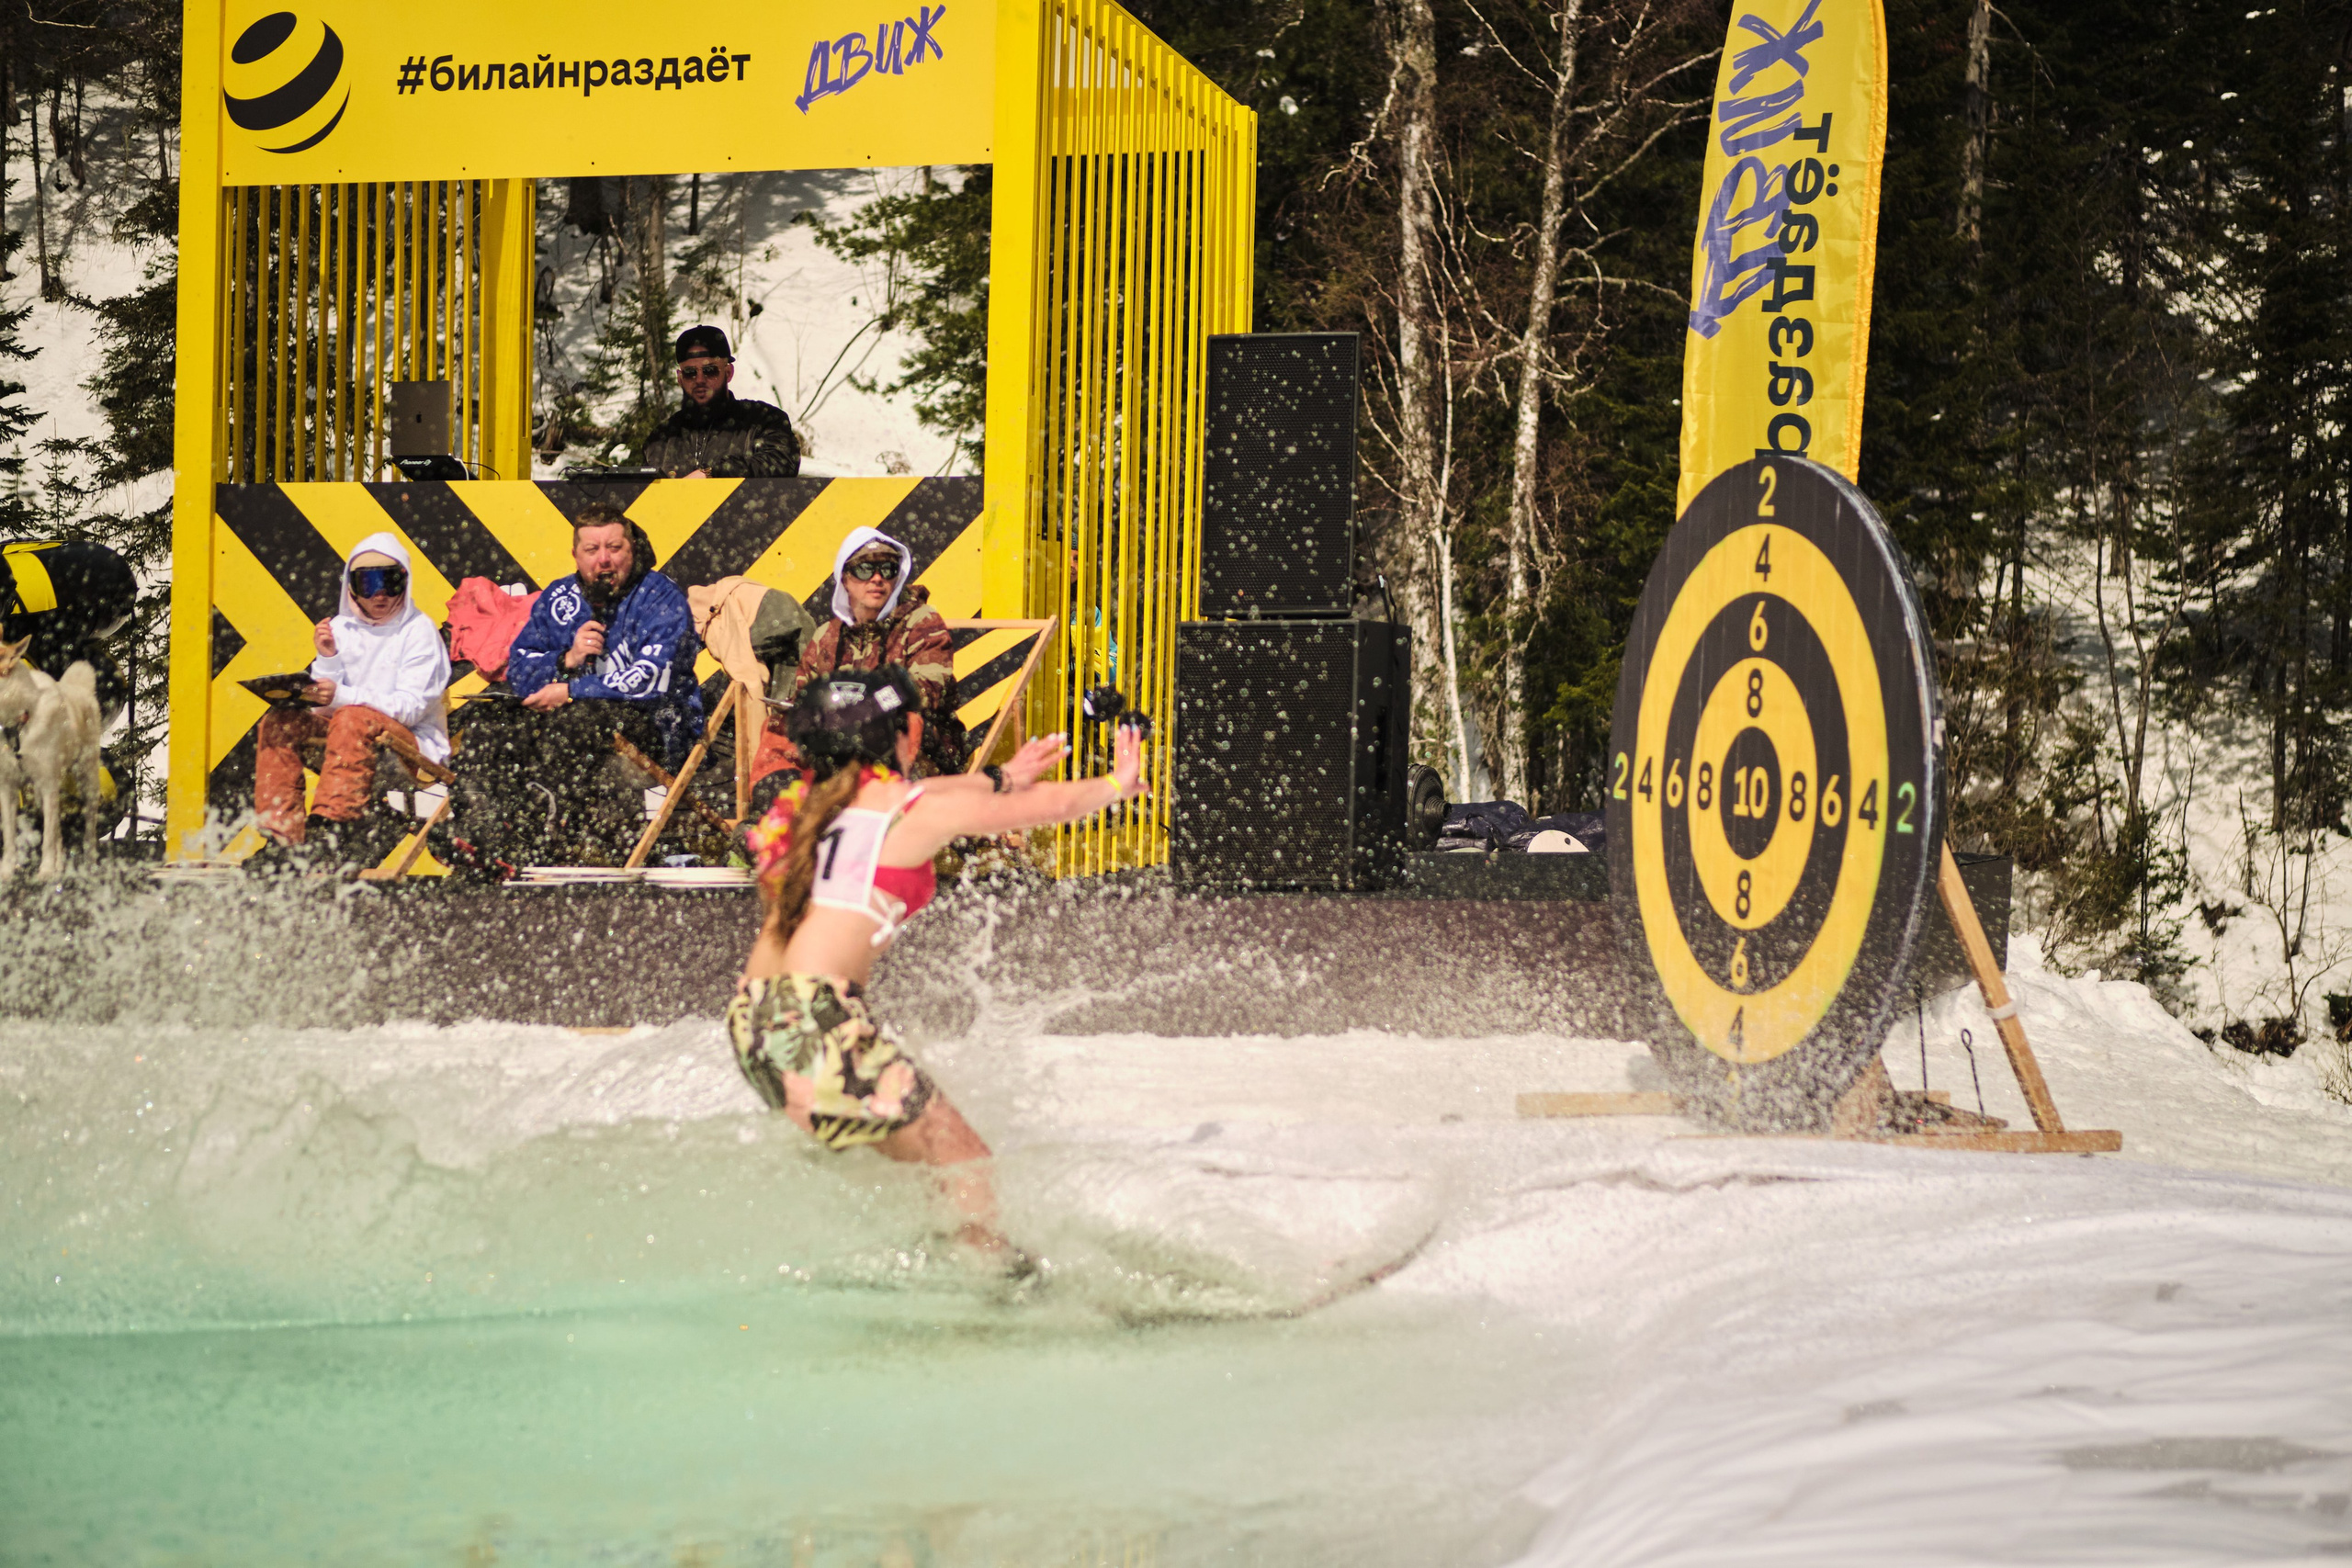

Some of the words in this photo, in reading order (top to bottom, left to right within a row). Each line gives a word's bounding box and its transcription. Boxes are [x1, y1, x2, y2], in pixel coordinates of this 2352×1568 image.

[397, 46, 751, 97] #билайнраздаёт
[795, 4, 946, 115] ДВИЖ
[1758, 465, 1776, 517] 2
[1755, 534, 1771, 582] 4
[1748, 600, 1769, 652] 6
[1747, 668, 1763, 718] 8
[1613, 751, 1629, 800] 2
[1637, 756, 1653, 803] 4
[1666, 758, 1684, 808] 6
[1697, 761, 1713, 811] 8
[1733, 766, 1770, 819] 10
[1789, 771, 1807, 822] 8
[1821, 774, 1842, 828] 6
[1858, 778, 1879, 830] 4
[1896, 782, 1915, 833] 2
[1736, 869, 1752, 919] 8
[1731, 937, 1748, 988] 6
